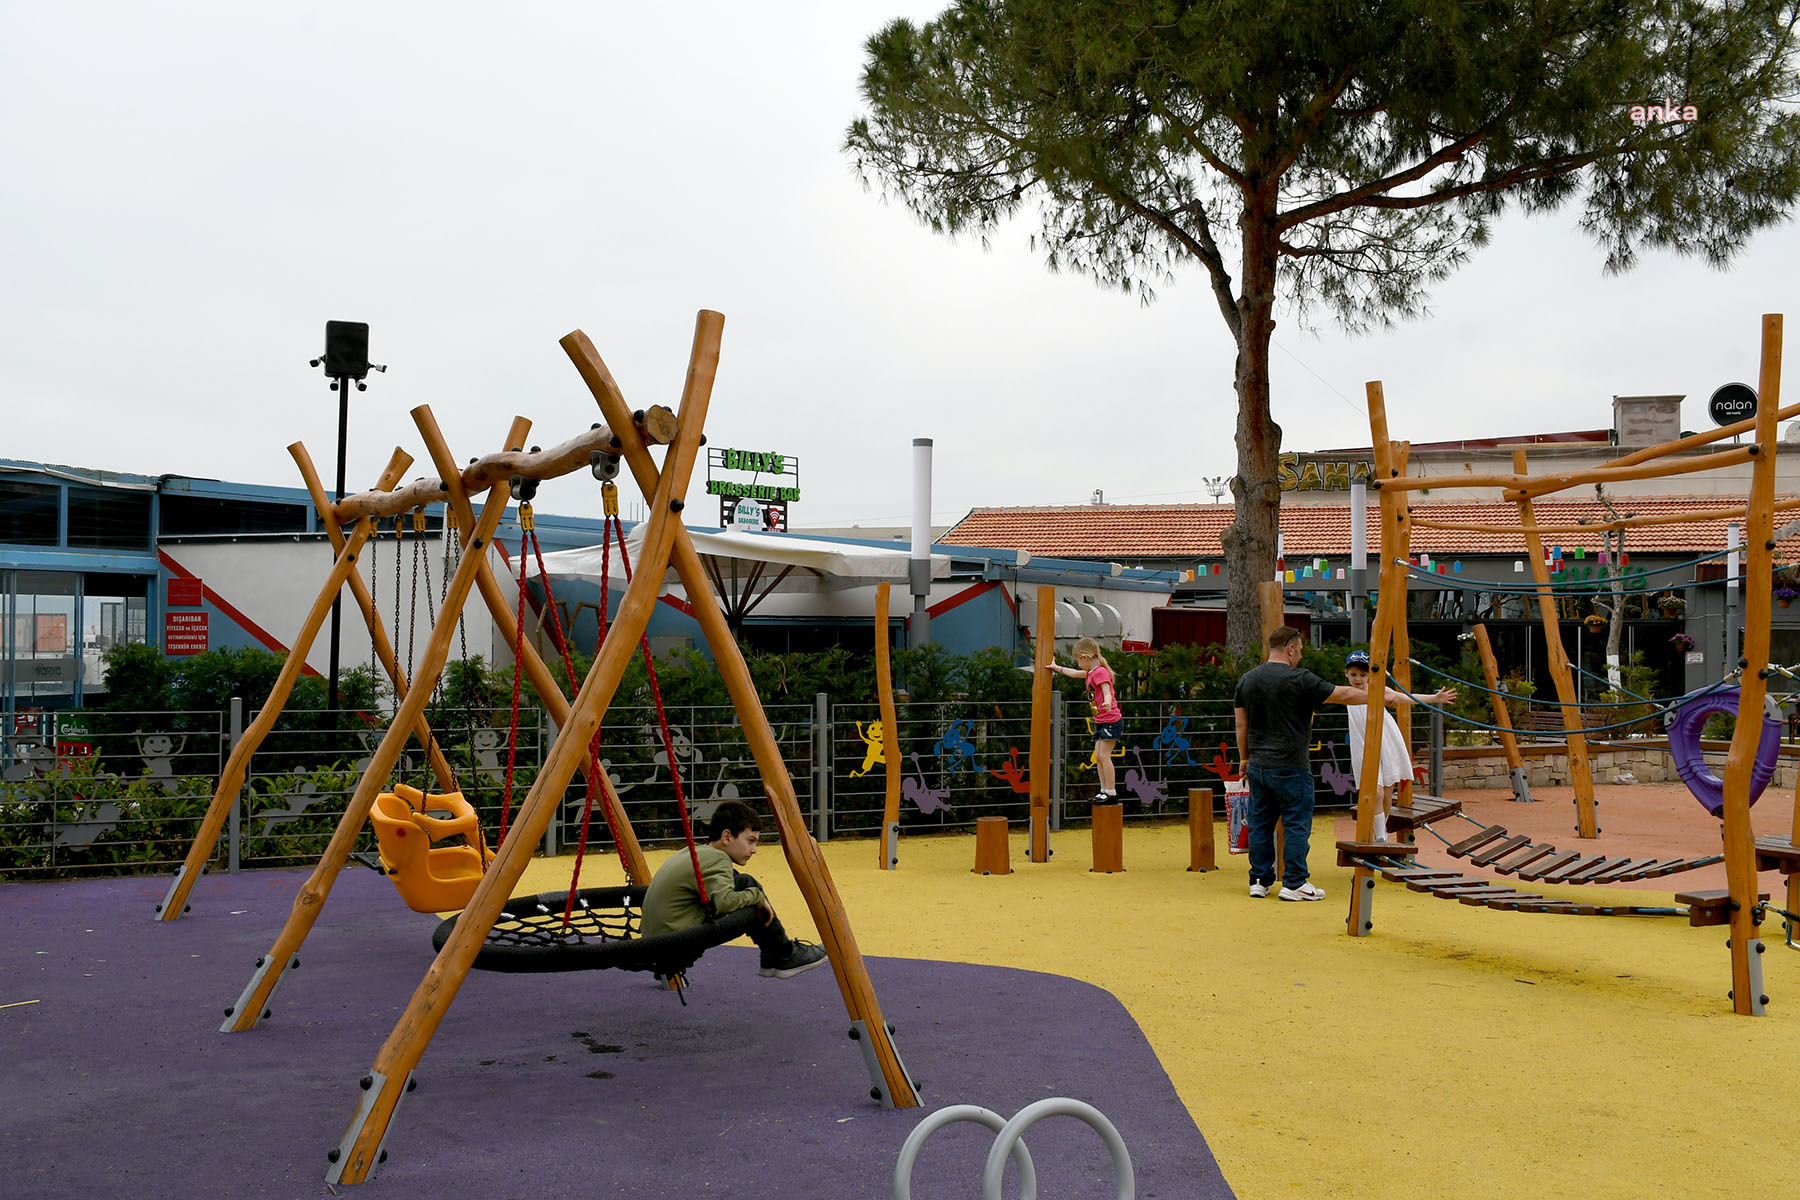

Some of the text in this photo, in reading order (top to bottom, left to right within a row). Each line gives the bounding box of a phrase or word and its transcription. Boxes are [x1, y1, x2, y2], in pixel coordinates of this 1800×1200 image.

[1715, 400, 1752, 410] nalan
[725, 448, 785, 474] BILLY'S
[709, 480, 801, 501] BRASSERIE BAR
[737, 504, 760, 517] BILLY'S
[60, 723, 89, 735] Carlsberg
